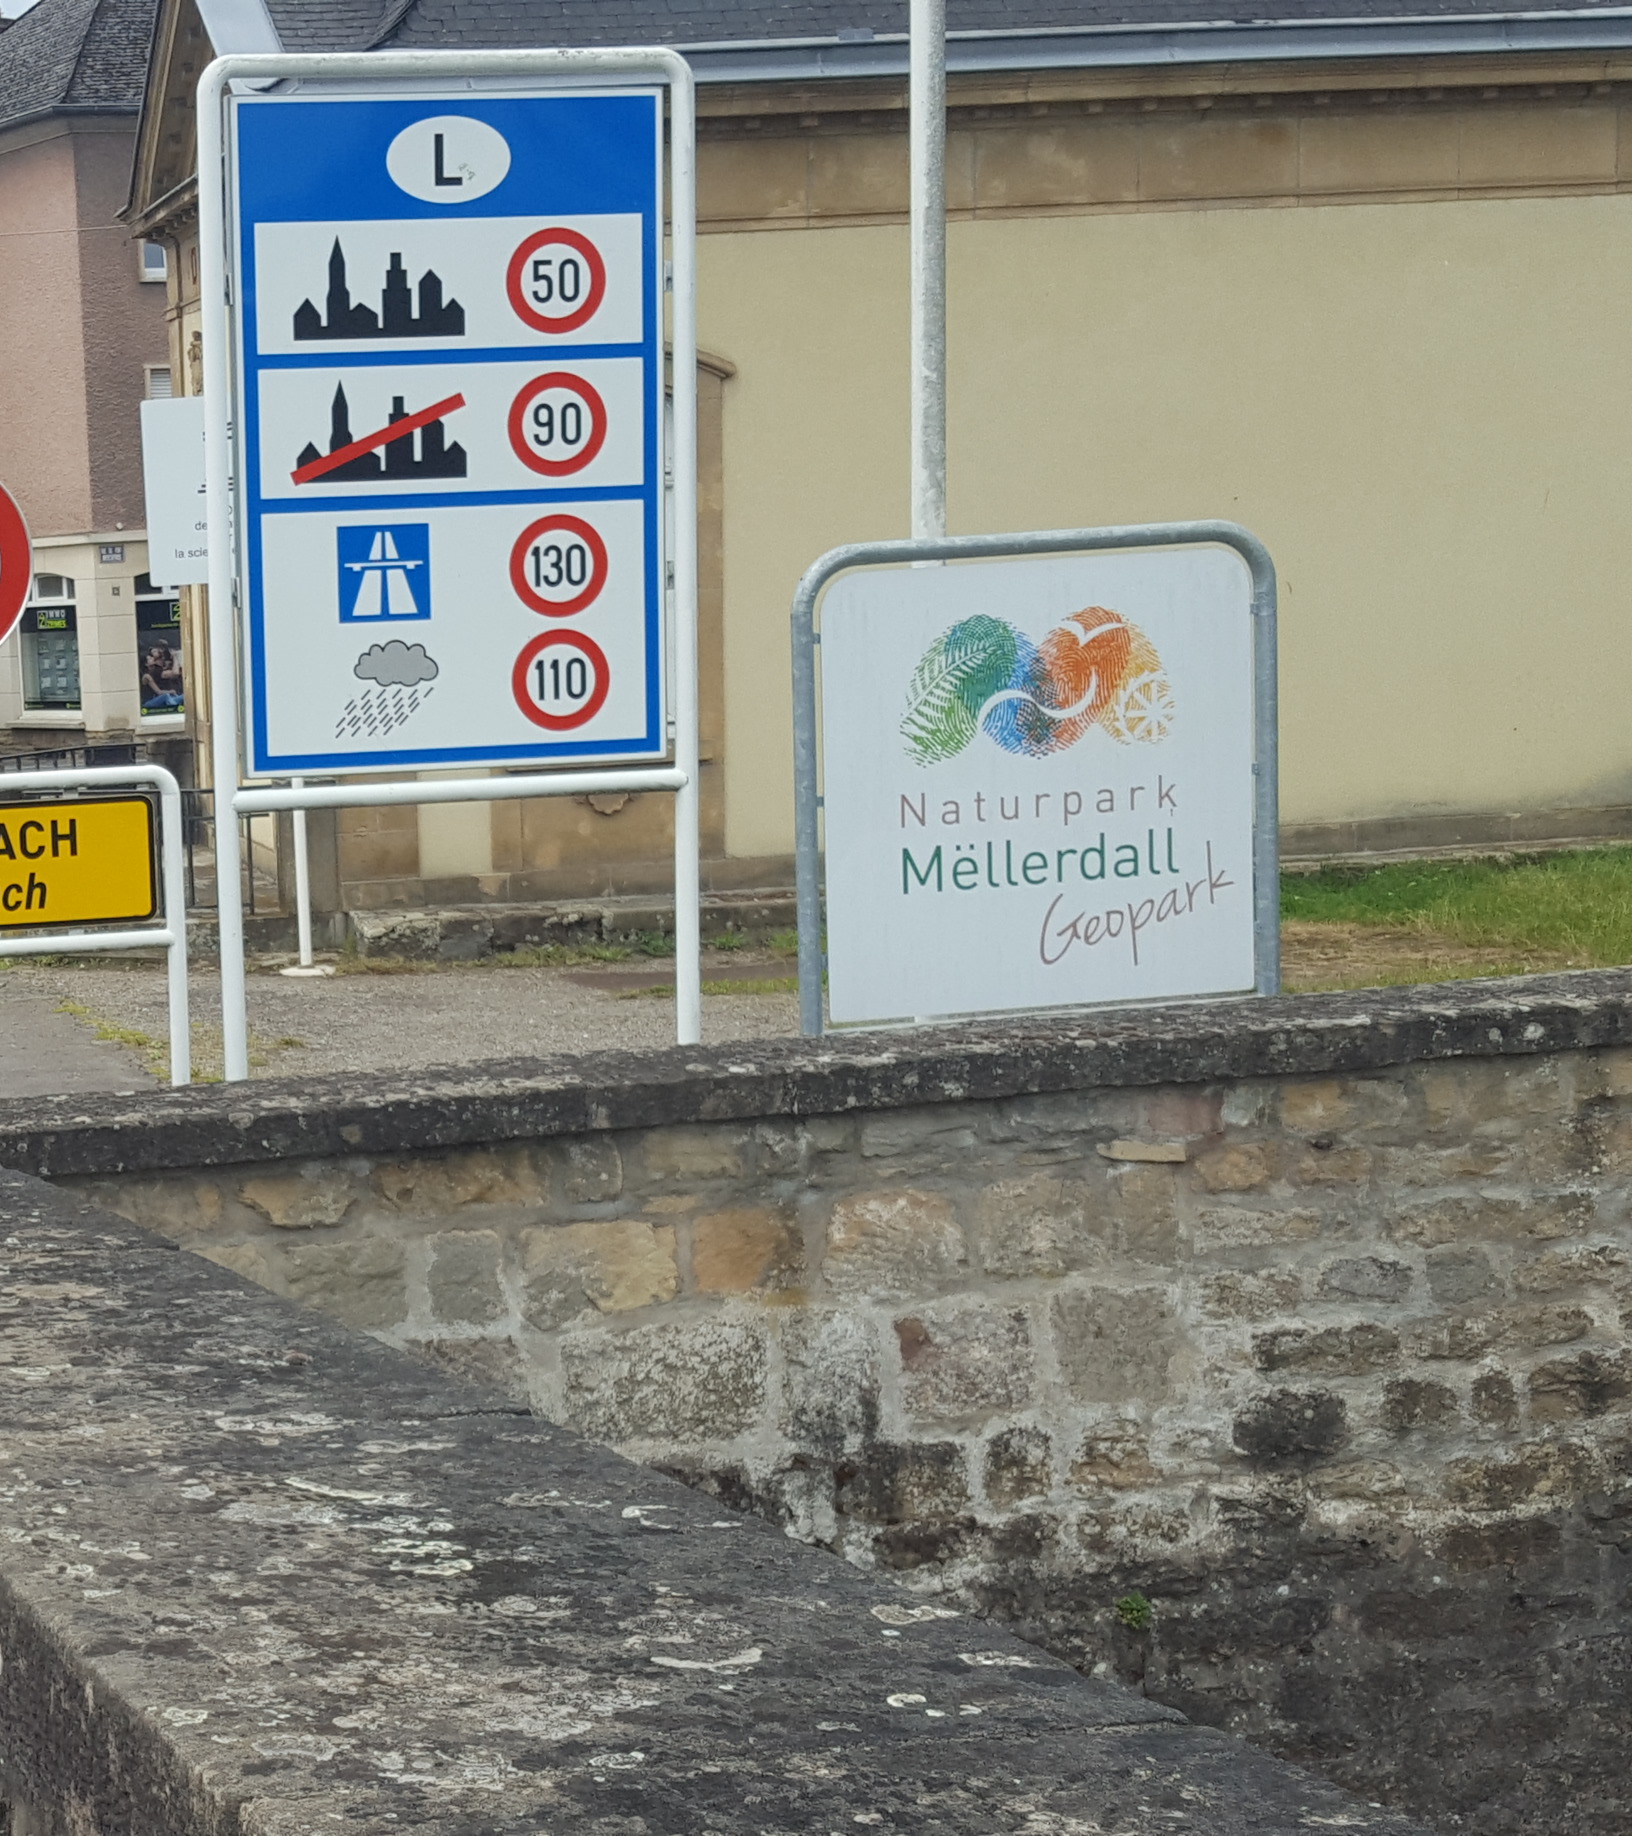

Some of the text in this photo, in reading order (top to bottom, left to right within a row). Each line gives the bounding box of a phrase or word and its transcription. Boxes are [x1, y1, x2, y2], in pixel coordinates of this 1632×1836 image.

[434, 133, 463, 187] L
[532, 258, 580, 304] 50
[532, 401, 582, 447] 90
[531, 543, 587, 589] 130
[535, 657, 587, 702] 110
[900, 774, 1178, 828] Naturpark
[901, 827, 1180, 895] Mëllerdall
[1039, 840, 1234, 966] Geopark
